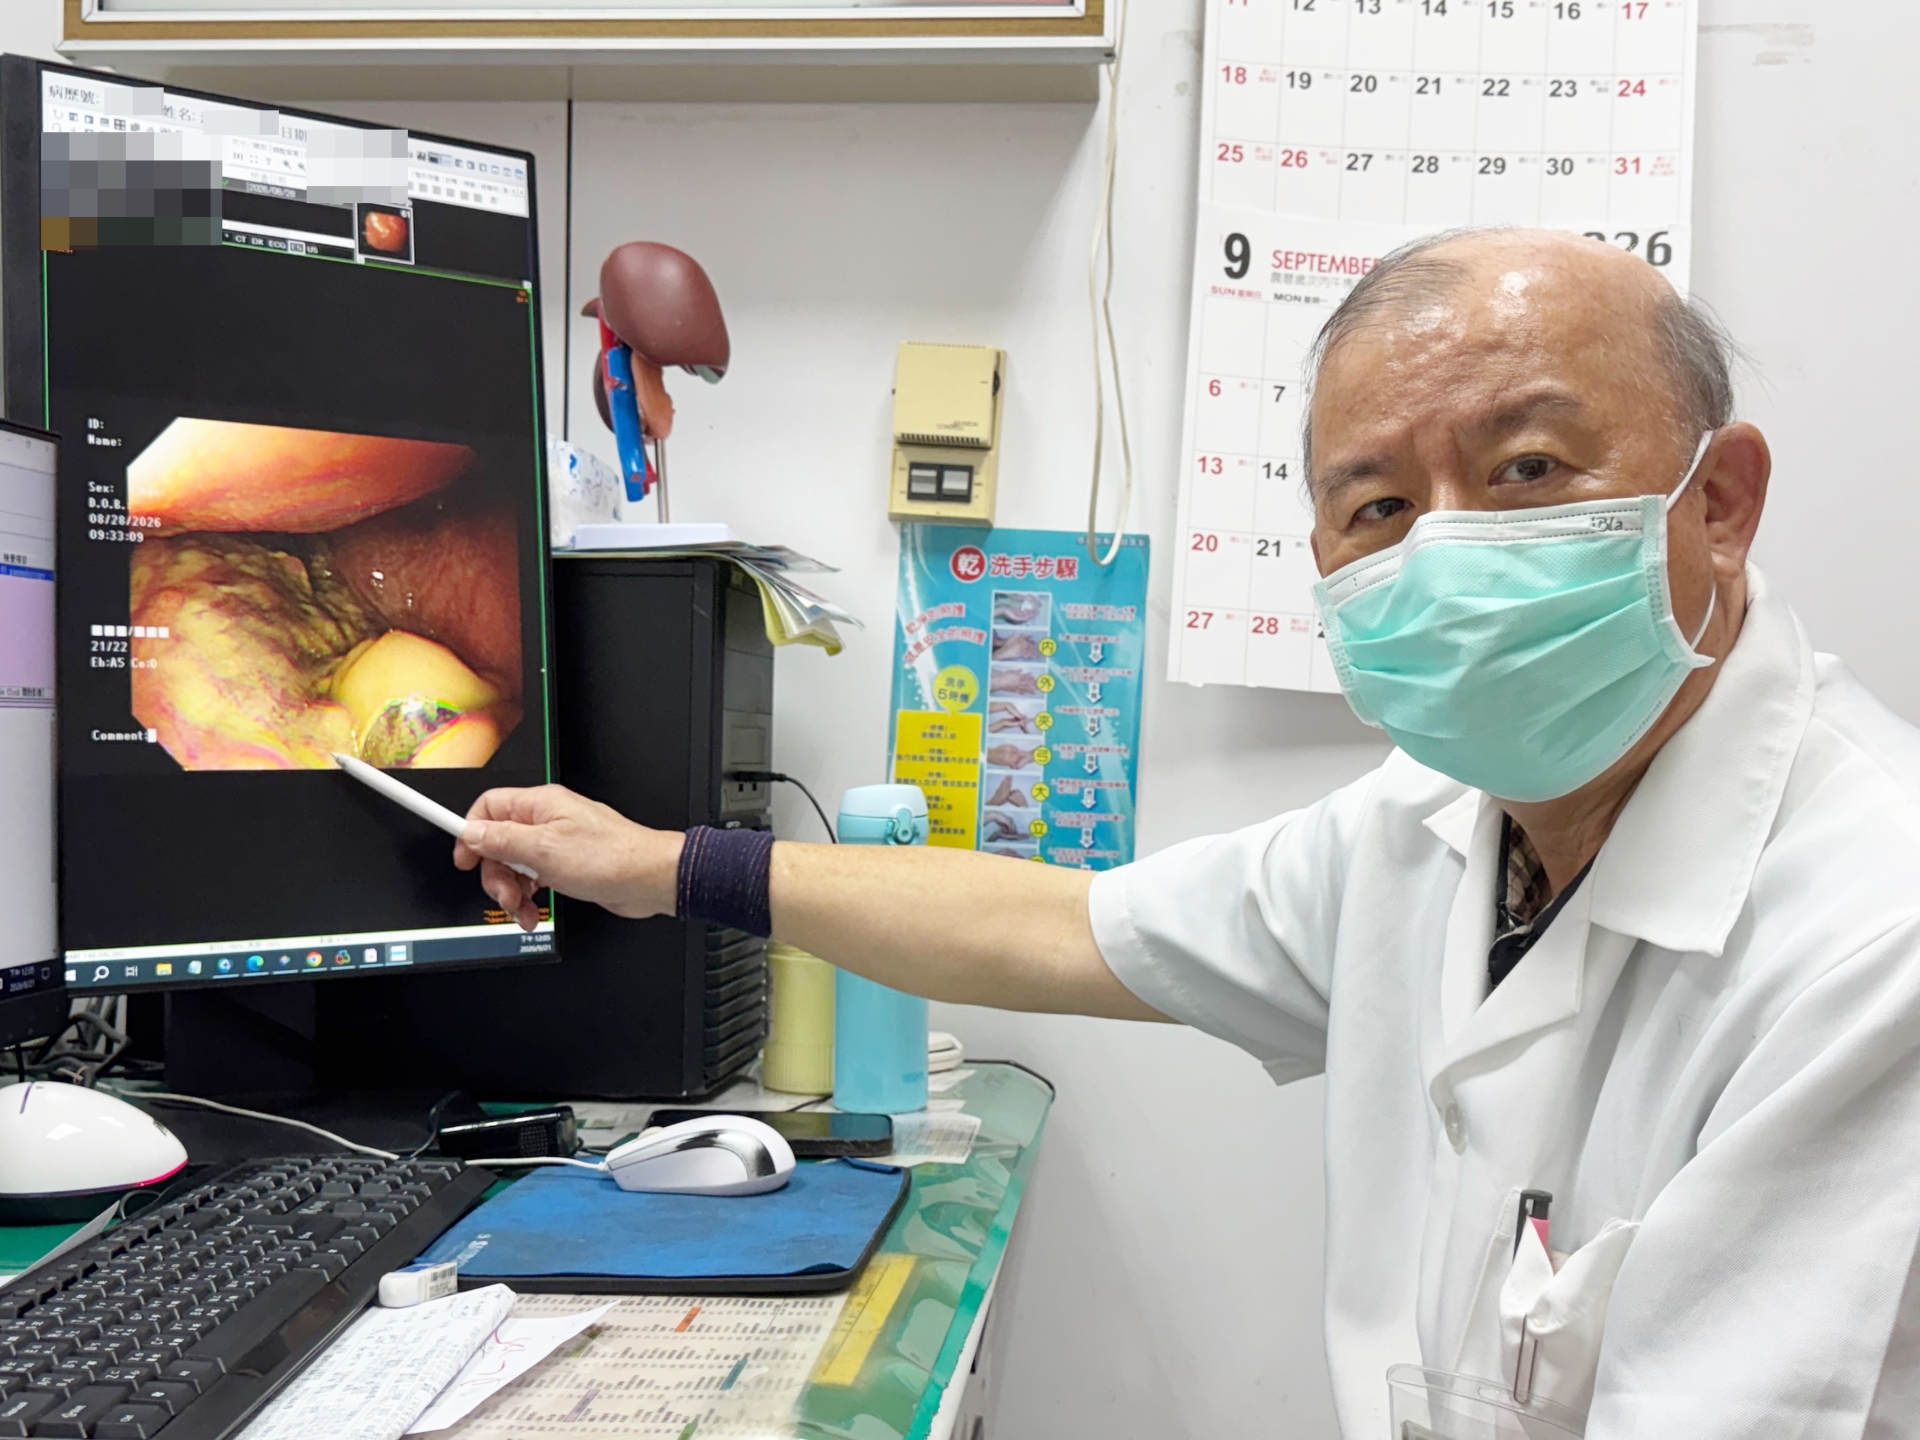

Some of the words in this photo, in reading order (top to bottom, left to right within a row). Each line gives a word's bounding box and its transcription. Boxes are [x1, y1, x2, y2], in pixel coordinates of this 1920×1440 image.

[1355, 0, 1382, 15] 13
[1420, 0, 1448, 17] 14
[1487, 1, 1514, 19] 15
[1554, 2, 1581, 20] 16
[1621, 2, 1649, 20] 17
[1221, 65, 1247, 85] 18
[1286, 71, 1312, 90] 19
[1349, 74, 1378, 93] 20
[1415, 77, 1442, 95] 21
[1481, 79, 1511, 97] 22
[1549, 80, 1578, 98] 23
[1617, 79, 1646, 97] 24
[1217, 143, 1245, 163] 25
[1281, 149, 1308, 168] 26
[1346, 153, 1374, 171] 27
[1411, 155, 1439, 174] 28
[1478, 157, 1507, 175] 29
[1546, 158, 1574, 176] 30
[1614, 157, 1642, 175] 31
[235, 234, 247, 243] CT
[1223, 232, 1251, 280] 9
[1210, 286, 1237, 298] SUN
[1273, 292, 1302, 303] MON
[1208, 378, 1221, 397] 6
[1273, 385, 1286, 402] 7
[88, 417, 104, 429] ID:
[87, 433, 122, 447] Name:
[1197, 456, 1223, 475] 13
[1262, 462, 1288, 480] 14
[87, 481, 115, 493] Sex:
[88, 512, 162, 528] 08/28/2026
[88, 529, 144, 543] 09:33:09
[1191, 533, 1218, 552] 20
[1256, 539, 1281, 557] 21
[957, 552, 981, 577] 乾
[989, 554, 1079, 579] 洗手步驟
[1187, 611, 1214, 629] 27
[1252, 616, 1279, 635] 28
[91, 641, 128, 652] 21/22
